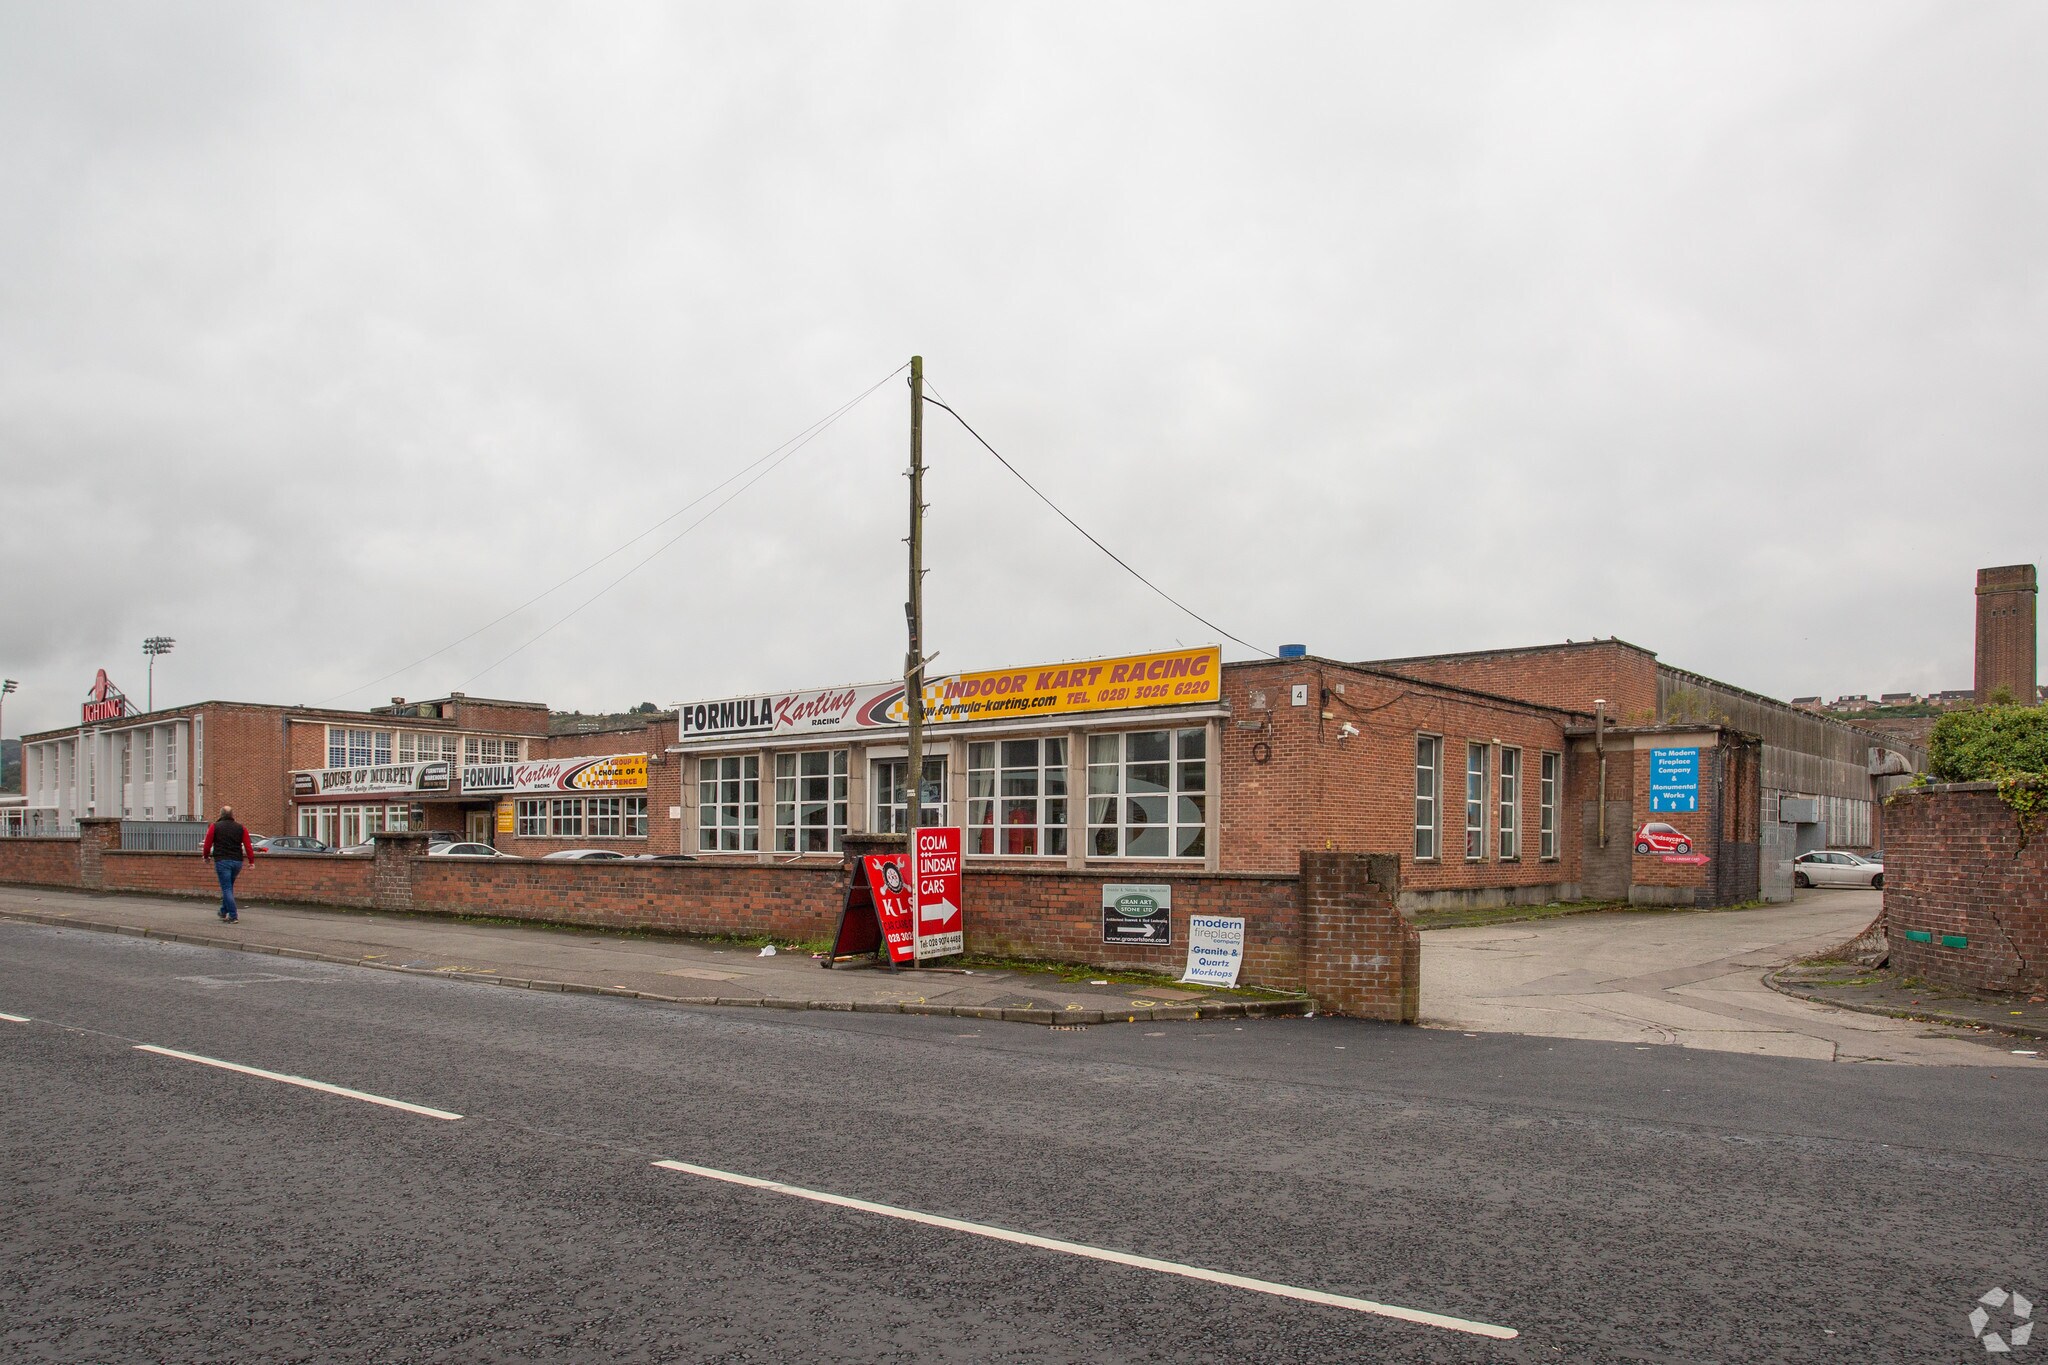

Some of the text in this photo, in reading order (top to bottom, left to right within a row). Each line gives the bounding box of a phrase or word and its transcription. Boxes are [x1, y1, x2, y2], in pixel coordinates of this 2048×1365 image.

[944, 655, 1210, 699] INDOOR KART RACING
[1066, 680, 1211, 705] TEL. (028) 3026 6220
[1297, 691, 1302, 699] 4
[83, 699, 120, 722] LIGHTING
[684, 688, 856, 731] FORMULA Karting
[811, 717, 840, 726] RACING
[322, 766, 415, 790] HOUSE OF MURPHY
[463, 763, 560, 788] FORMULA Karting
[591, 778, 637, 786] CONFERENCE
[920, 835, 948, 850] COLM
[921, 857, 957, 873] LINDSAY
[921, 879, 945, 895] CARS
[1193, 919, 1242, 929] modern
[888, 933, 900, 943] 028
[1194, 927, 1242, 941] fireplace
[920, 940, 928, 948] Tel:
[1193, 946, 1238, 957] Granite &
[1198, 957, 1230, 967] Quartz
[1191, 968, 1233, 978] Worktops
